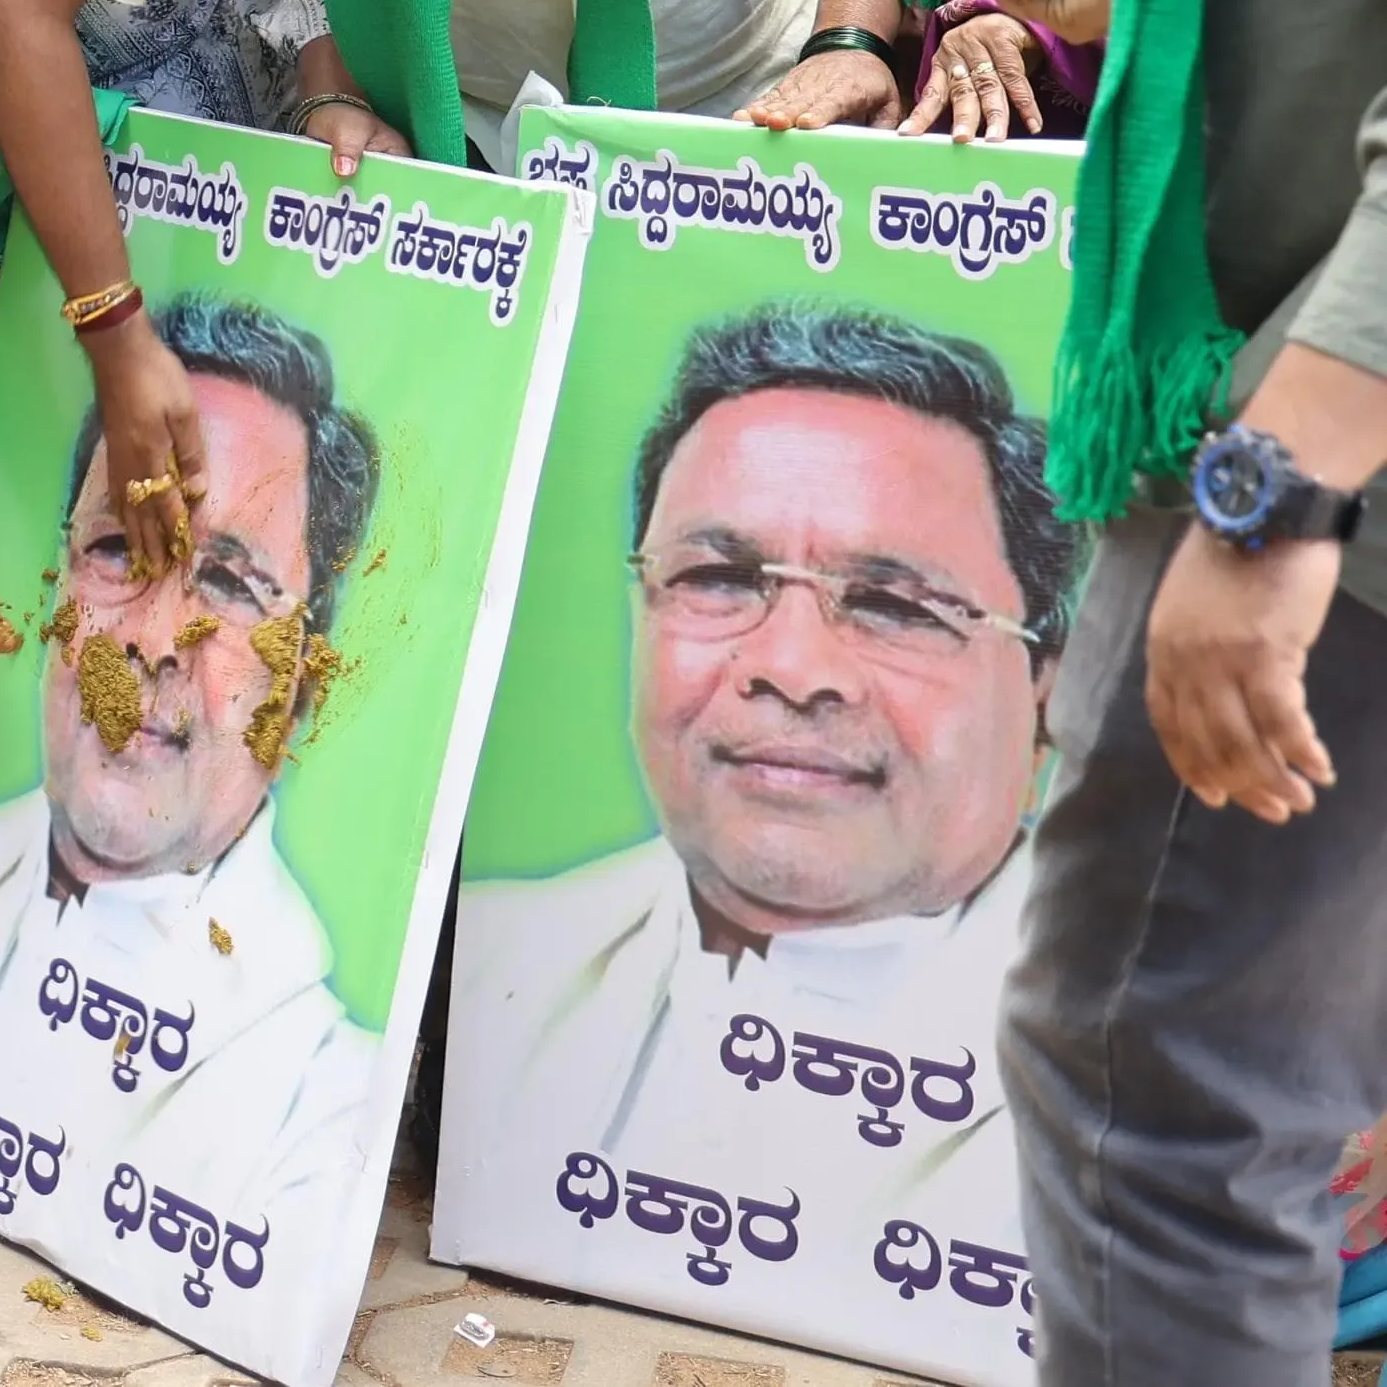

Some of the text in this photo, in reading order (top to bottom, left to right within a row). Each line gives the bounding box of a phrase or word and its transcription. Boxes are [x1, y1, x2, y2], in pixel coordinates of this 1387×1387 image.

[104, 150, 526, 318] ದ್ದರಾಮಯ್ಯ ಕಾಂಗ್ರೆಸ್ ಸರ್ಕಾರಕ್ಕೆ
[609, 156, 834, 264] ಸಿದ್ದರಾಮಯ್ಯ
[878, 189, 1047, 272] ಕಾಂಗ್ರೆಸ್
[38, 957, 195, 1093] ಧಿಕ್ಕಾರ
[720, 1013, 976, 1147] ಧಿಕ್ಕಾರ
[103, 1163, 269, 1308] ಧಿಕ್ಕಾರ
[555, 1151, 800, 1286] ಧಿಕ್ಕಾರ
